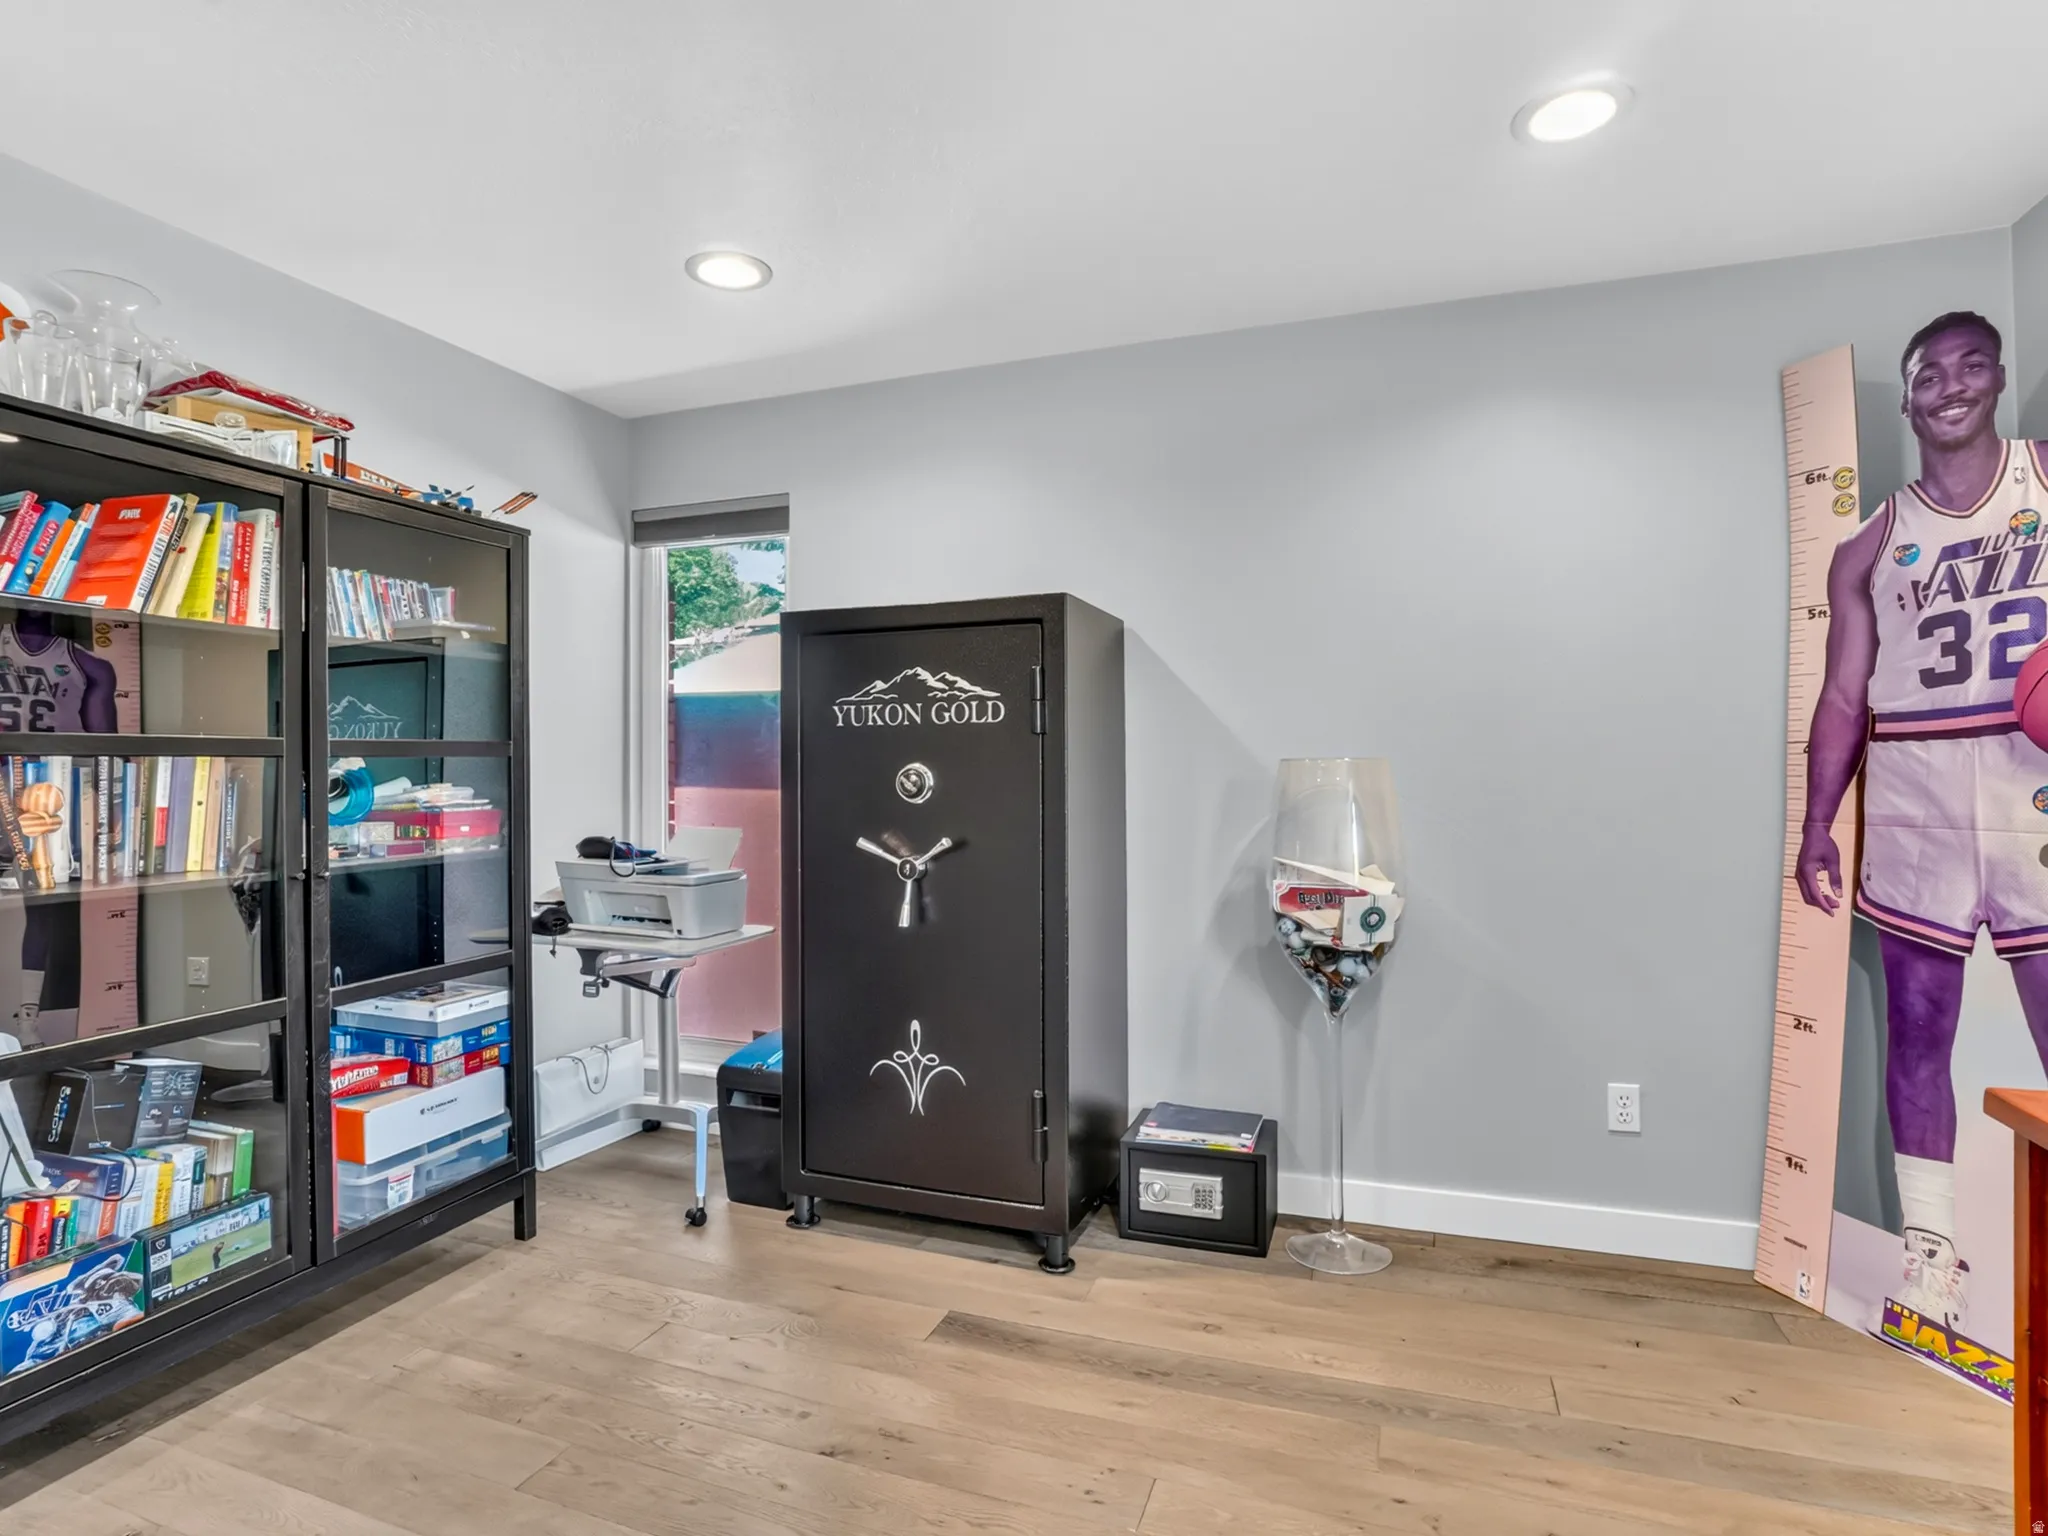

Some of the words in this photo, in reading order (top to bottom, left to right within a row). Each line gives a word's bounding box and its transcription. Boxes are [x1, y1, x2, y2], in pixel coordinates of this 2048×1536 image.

[1917, 595, 2048, 689] 32
[832, 702, 923, 727] YUKON
[931, 700, 1006, 724] GOLD
[1883, 1315, 2014, 1383] JAZZ
